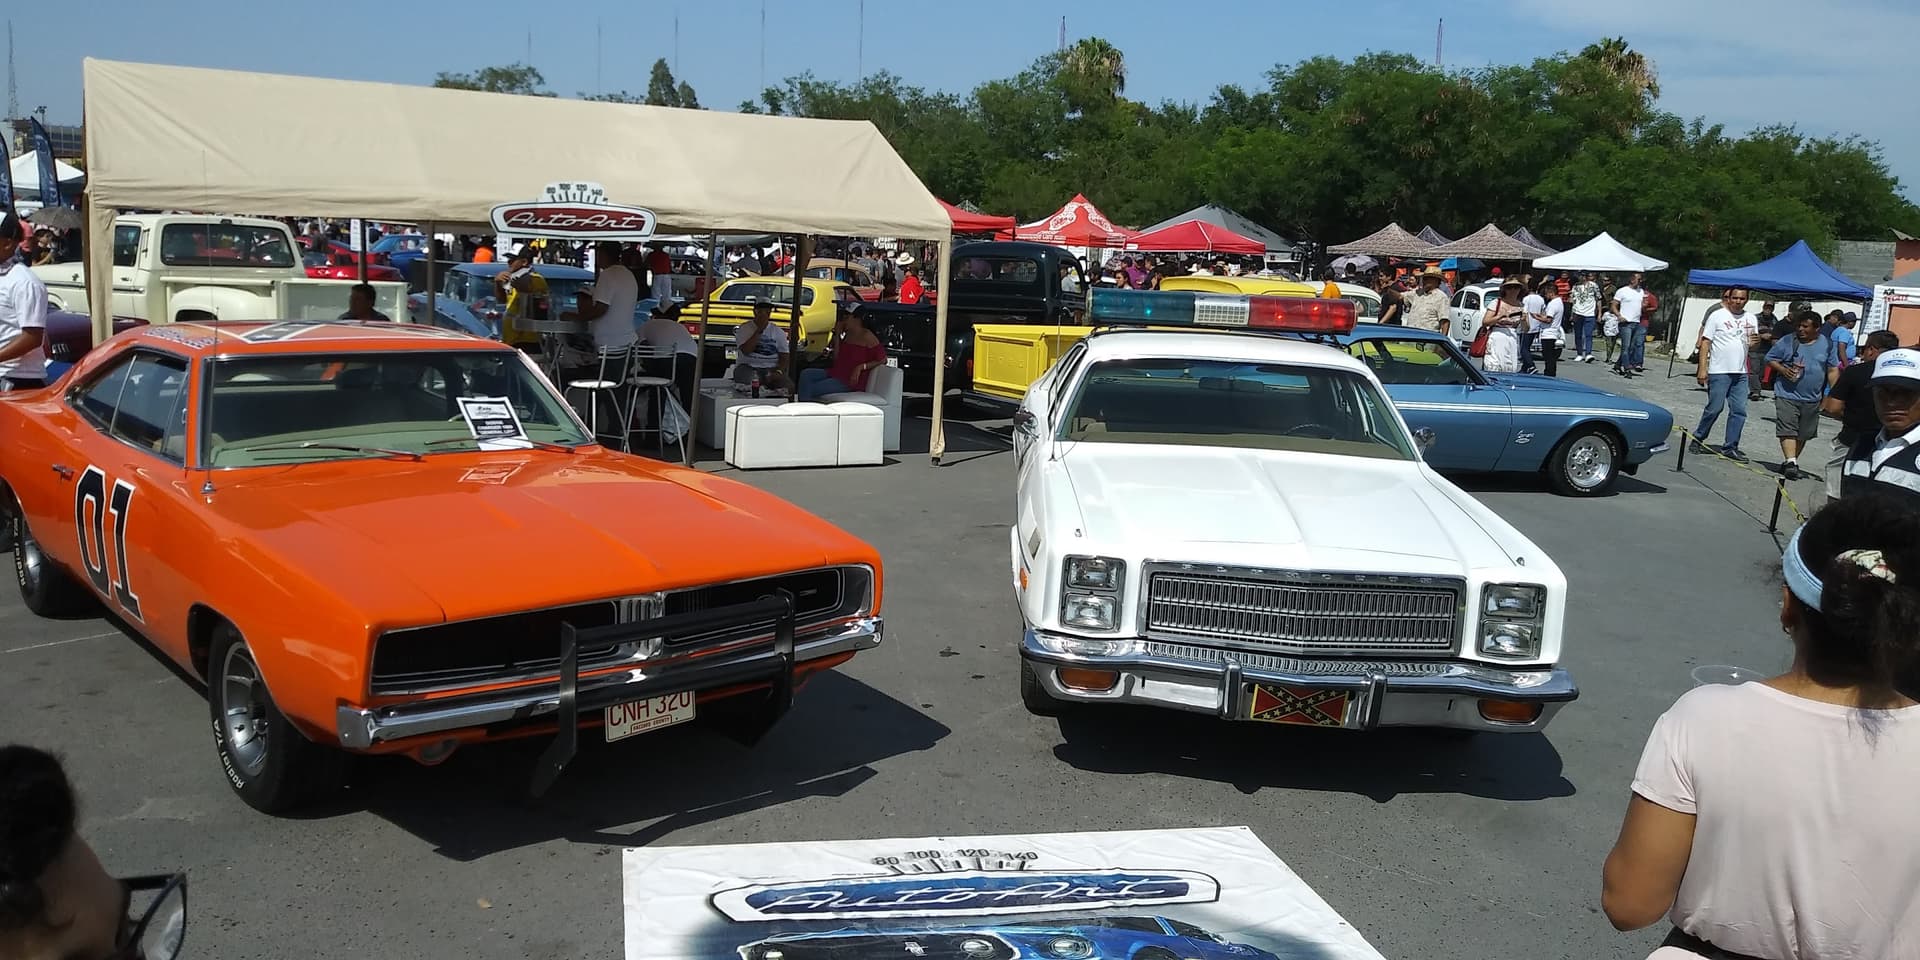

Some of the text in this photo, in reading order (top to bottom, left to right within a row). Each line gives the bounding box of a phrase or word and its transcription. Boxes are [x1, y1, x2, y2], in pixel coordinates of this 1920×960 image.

[546, 183, 604, 196] 80 100 120 140
[506, 211, 646, 229] AutoArt
[1462, 319, 1471, 330] 53
[75, 463, 146, 624] 01
[609, 691, 691, 726] CNH 320
[220, 751, 246, 789] Radial
[873, 848, 1039, 866] 80 100 120 140
[756, 878, 1166, 911] AutoArt
